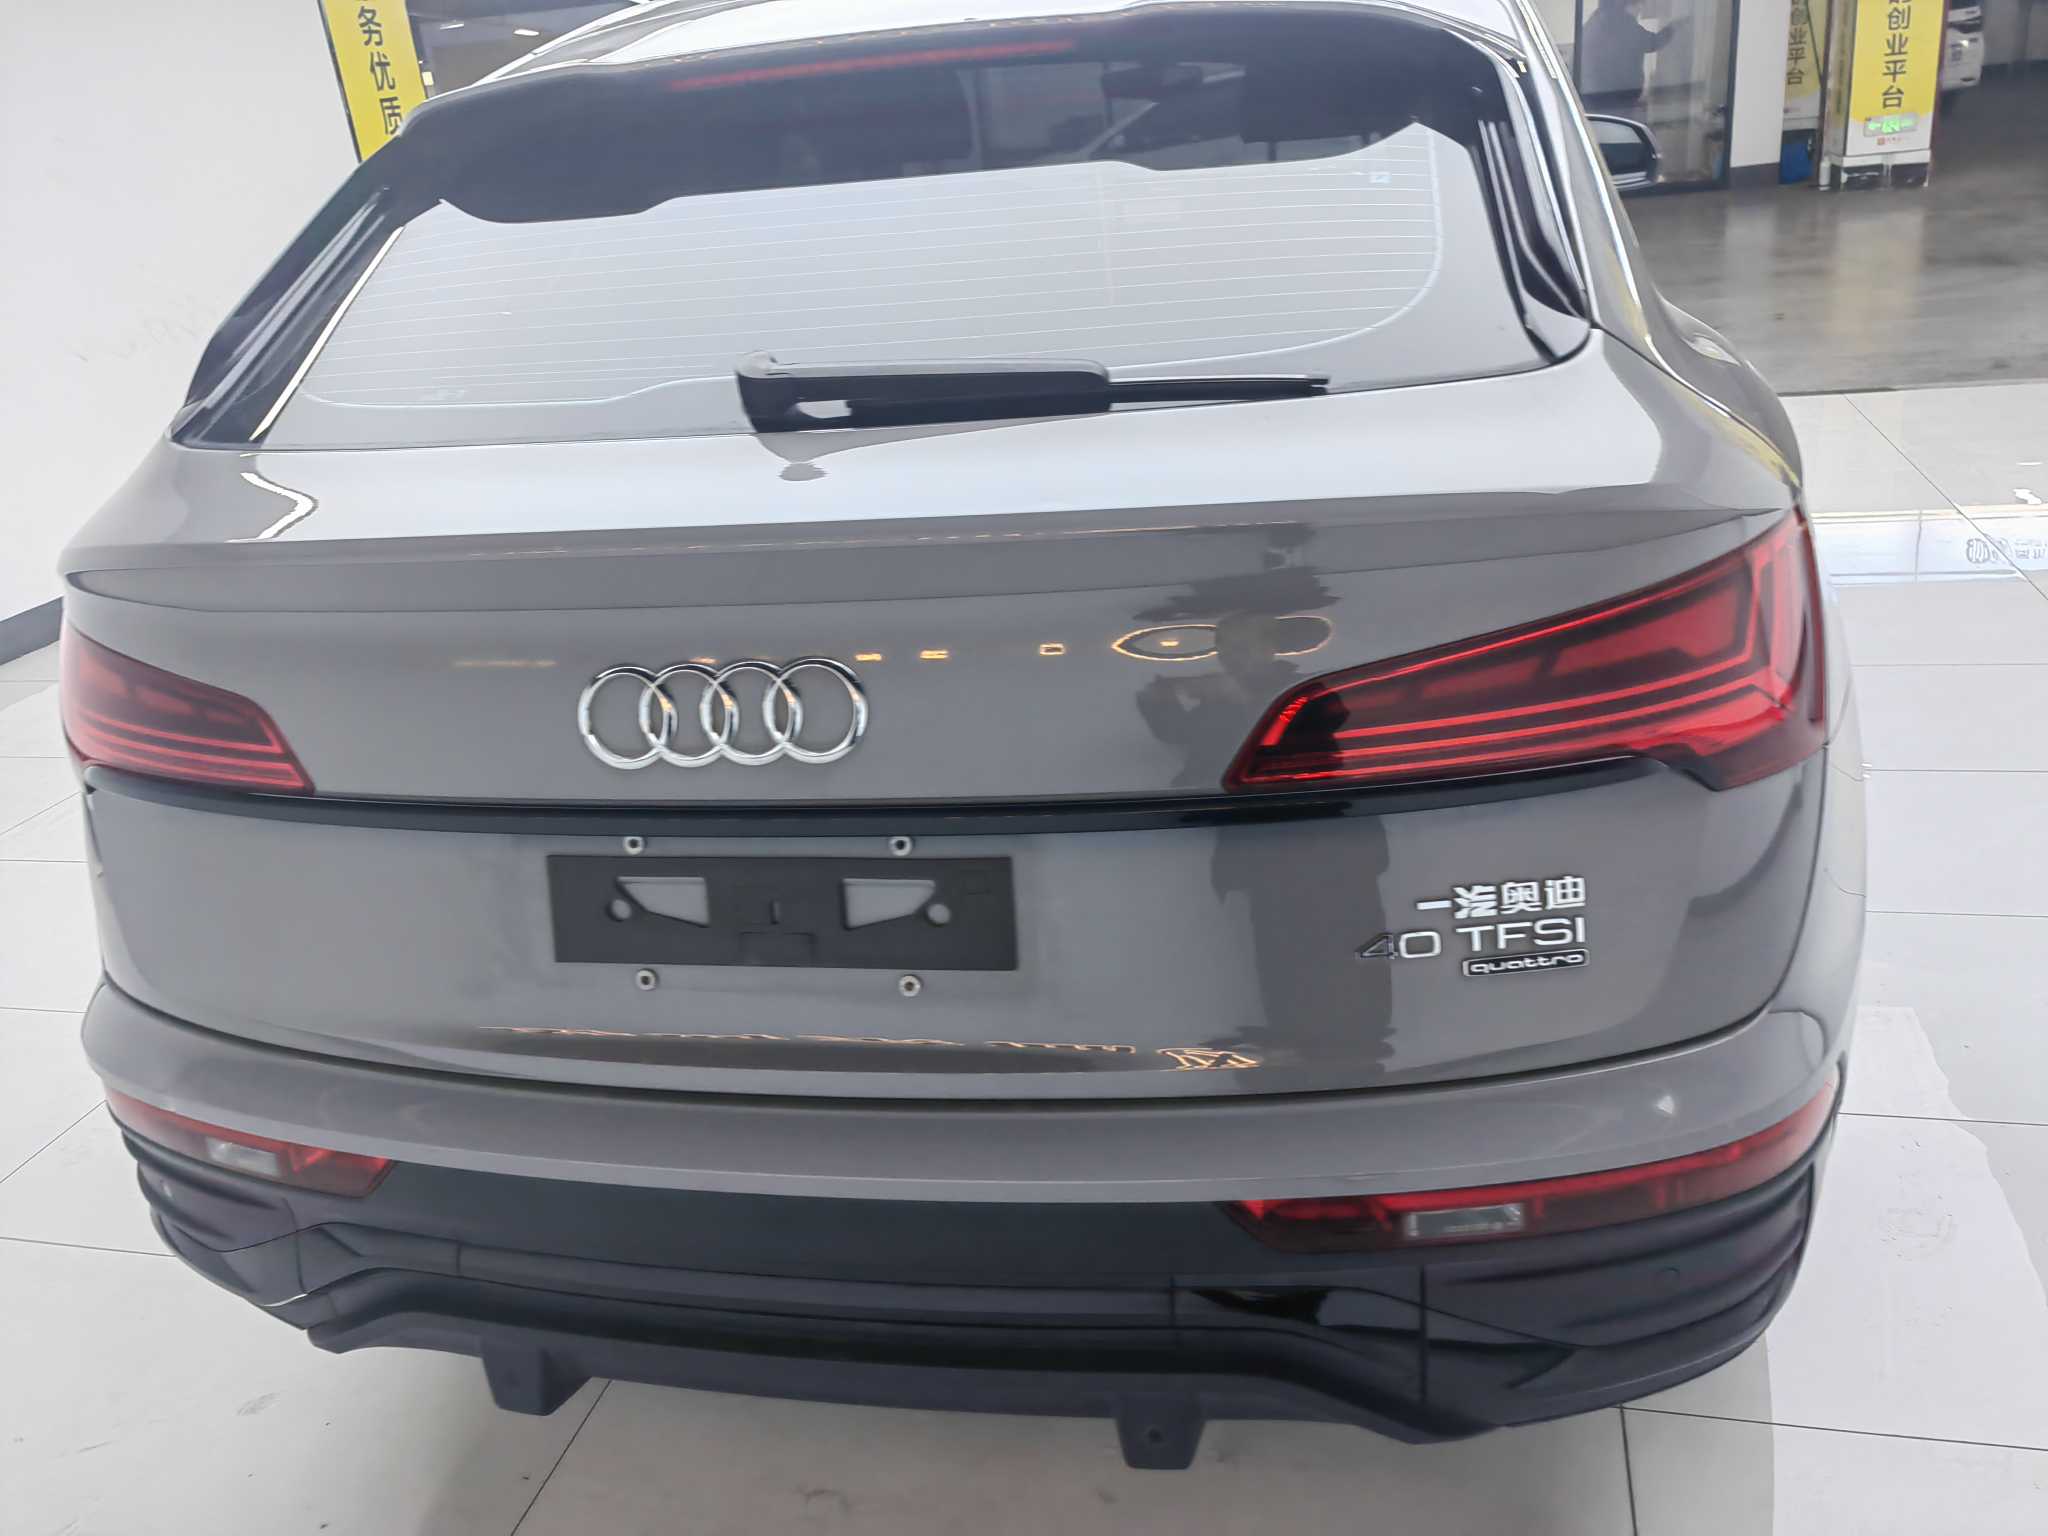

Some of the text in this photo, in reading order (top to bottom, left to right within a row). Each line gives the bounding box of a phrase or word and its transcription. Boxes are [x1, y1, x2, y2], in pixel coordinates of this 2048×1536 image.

[357, 0, 402, 135] 务优质
[1882, 0, 1912, 109] 创业平台
[1415, 876, 1587, 919] 一汽奥迪
[1355, 917, 1586, 960] 40 TFSI
[1467, 952, 1586, 975] quattro
